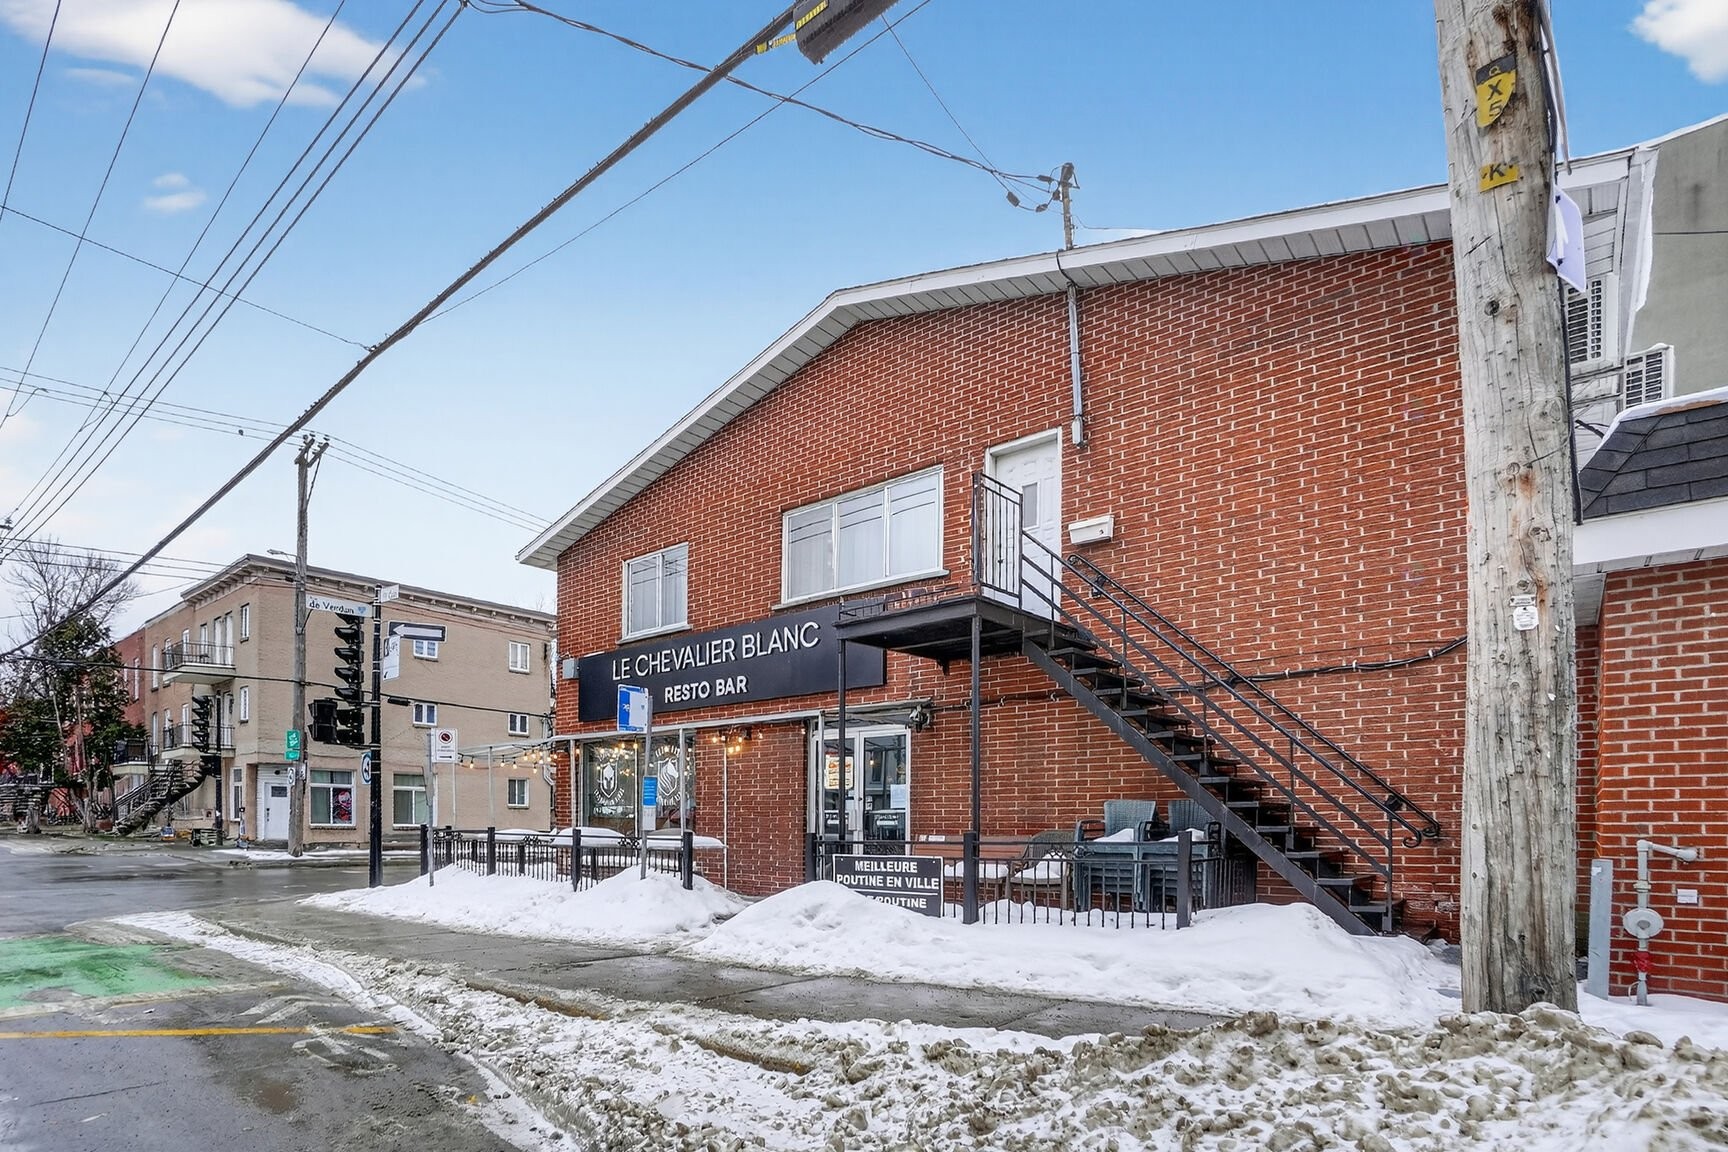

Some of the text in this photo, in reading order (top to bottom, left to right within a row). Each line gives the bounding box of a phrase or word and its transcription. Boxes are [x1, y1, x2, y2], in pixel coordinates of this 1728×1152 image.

[309, 599, 355, 614] de Verdun
[612, 621, 820, 681] LE CHEVALIER BLANC
[664, 675, 748, 704] RESTO BAR
[854, 860, 918, 873] MEILLEURE
[836, 873, 939, 890] POUTINE EN VILLE
